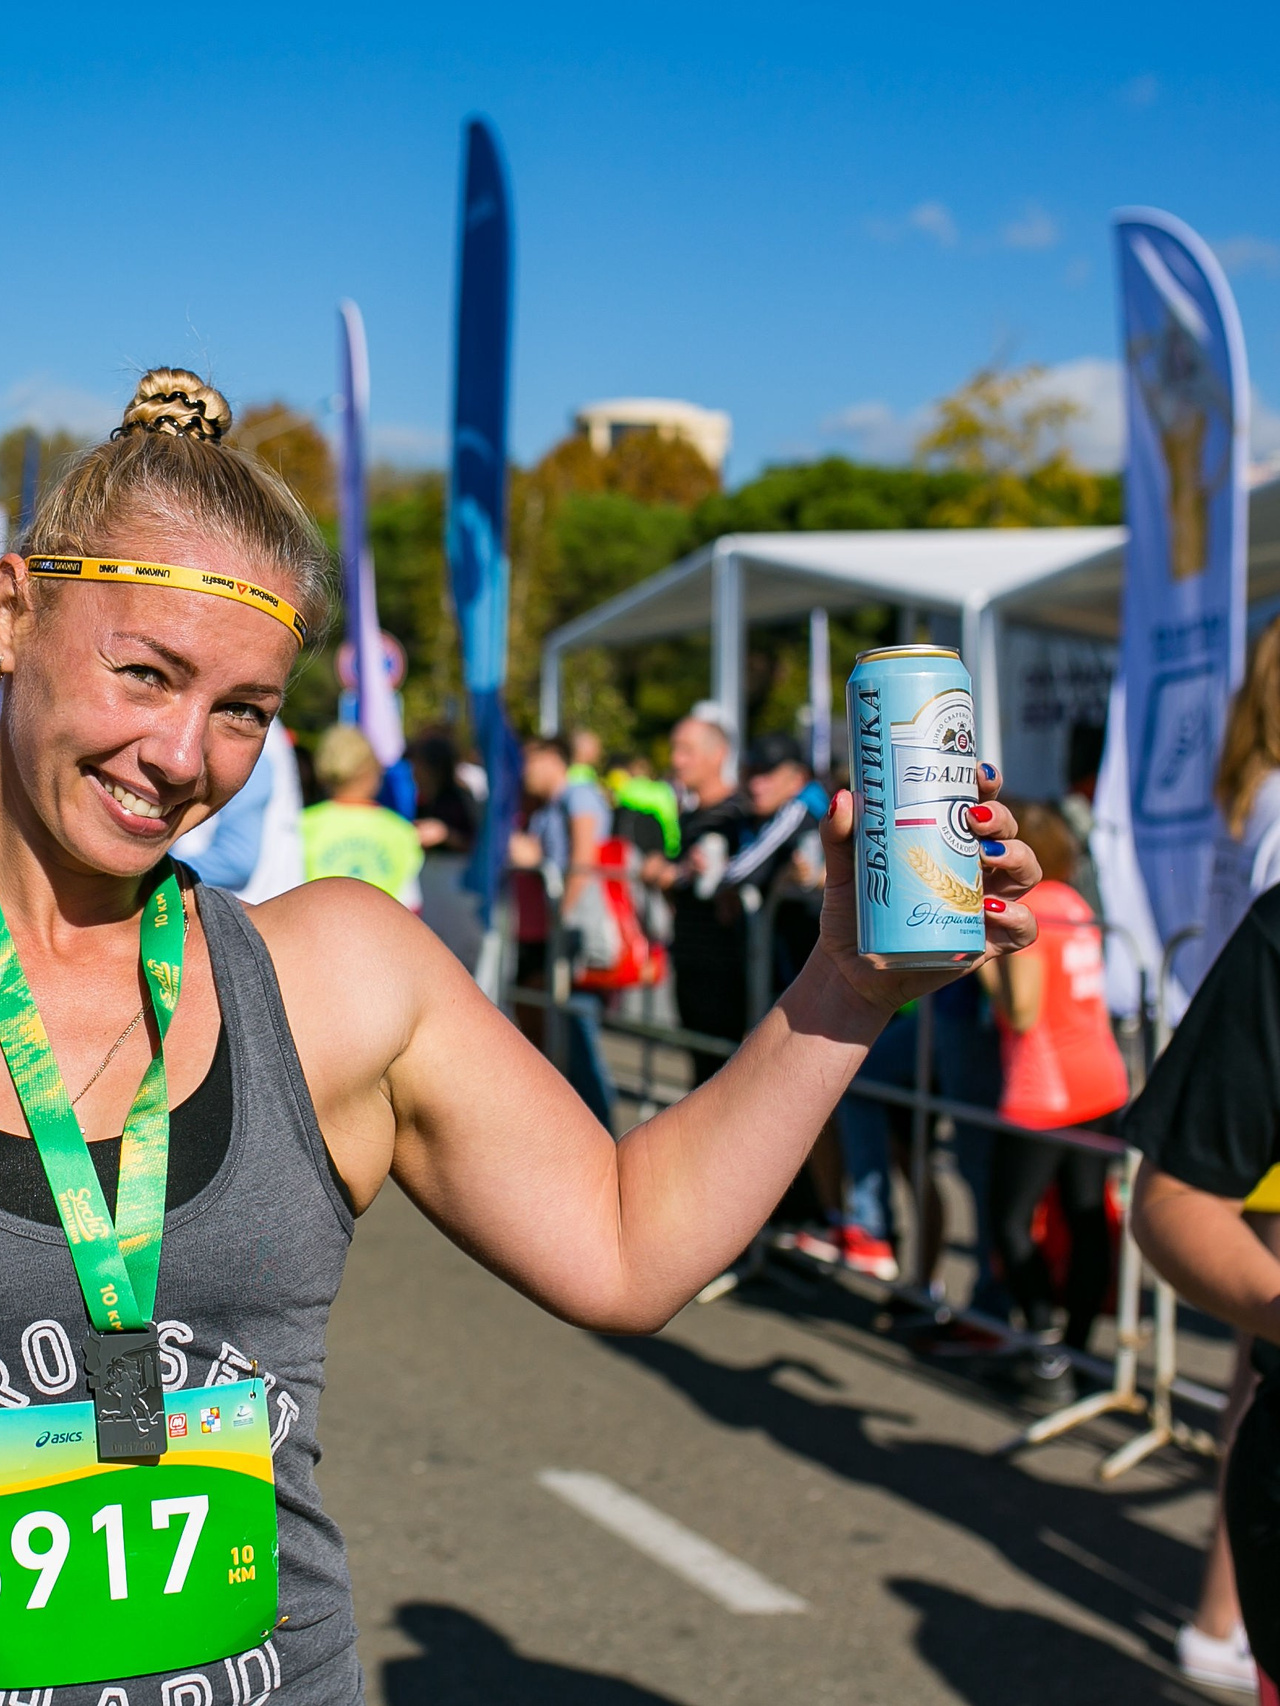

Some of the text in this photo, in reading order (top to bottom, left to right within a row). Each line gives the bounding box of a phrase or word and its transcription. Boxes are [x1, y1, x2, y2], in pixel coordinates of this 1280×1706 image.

[202, 574, 279, 607] Reebok CrossFit
[858, 687, 890, 874] БАЛТИКА
[941, 825, 978, 853] БЕЗАЛКОГО
[154, 914, 168, 928] 10
[59, 1193, 81, 1244] MARATHON
[68, 1188, 110, 1242] Sochi
[100, 1283, 118, 1306] 10
[51, 1431, 83, 1444] asics
[230, 1546, 255, 1566] 10
[228, 1566, 257, 1585] KM
